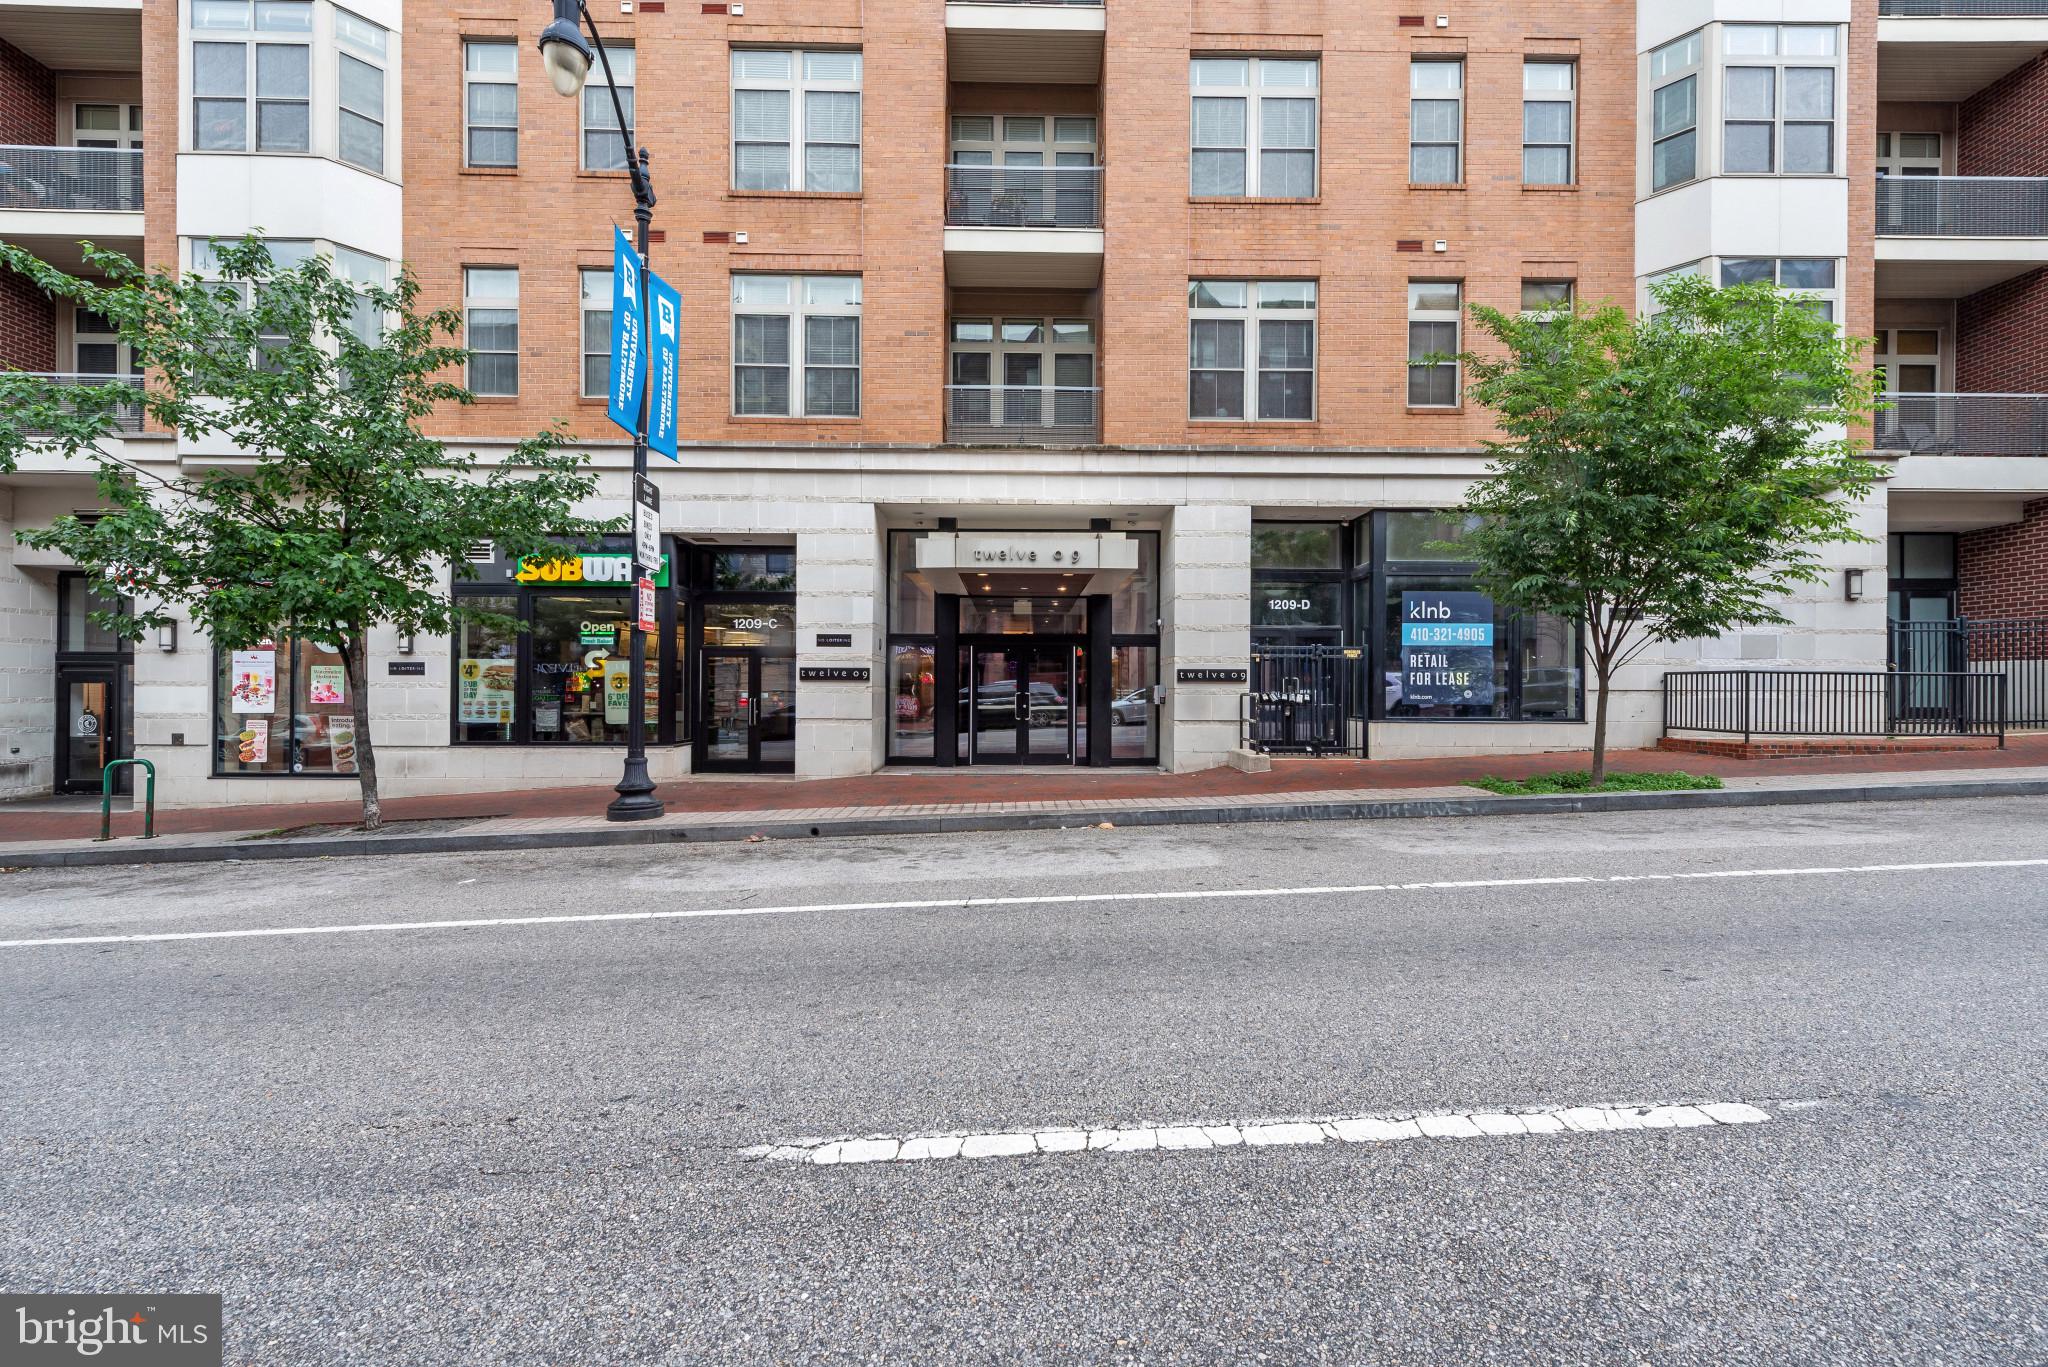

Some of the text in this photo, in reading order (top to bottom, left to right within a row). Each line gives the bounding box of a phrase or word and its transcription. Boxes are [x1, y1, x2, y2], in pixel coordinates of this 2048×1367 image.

[618, 311, 631, 411] OF BALTIMORE
[626, 318, 638, 401] UNIVERSITY
[658, 346, 669, 439] OF BALTIMORE
[974, 544, 1037, 561] twelve
[515, 556, 667, 582] SUBWA
[1269, 599, 1311, 610] 1209-D
[1410, 600, 1451, 619] klnb
[580, 621, 615, 634] Open
[733, 618, 778, 629] 1209-C
[1410, 627, 1485, 641] 410-321-4905
[1410, 654, 1449, 668] RETAIL
[801, 668, 847, 677] twelve
[1179, 669, 1225, 679] twelve
[1410, 672, 1470, 686] FOR LEASE
